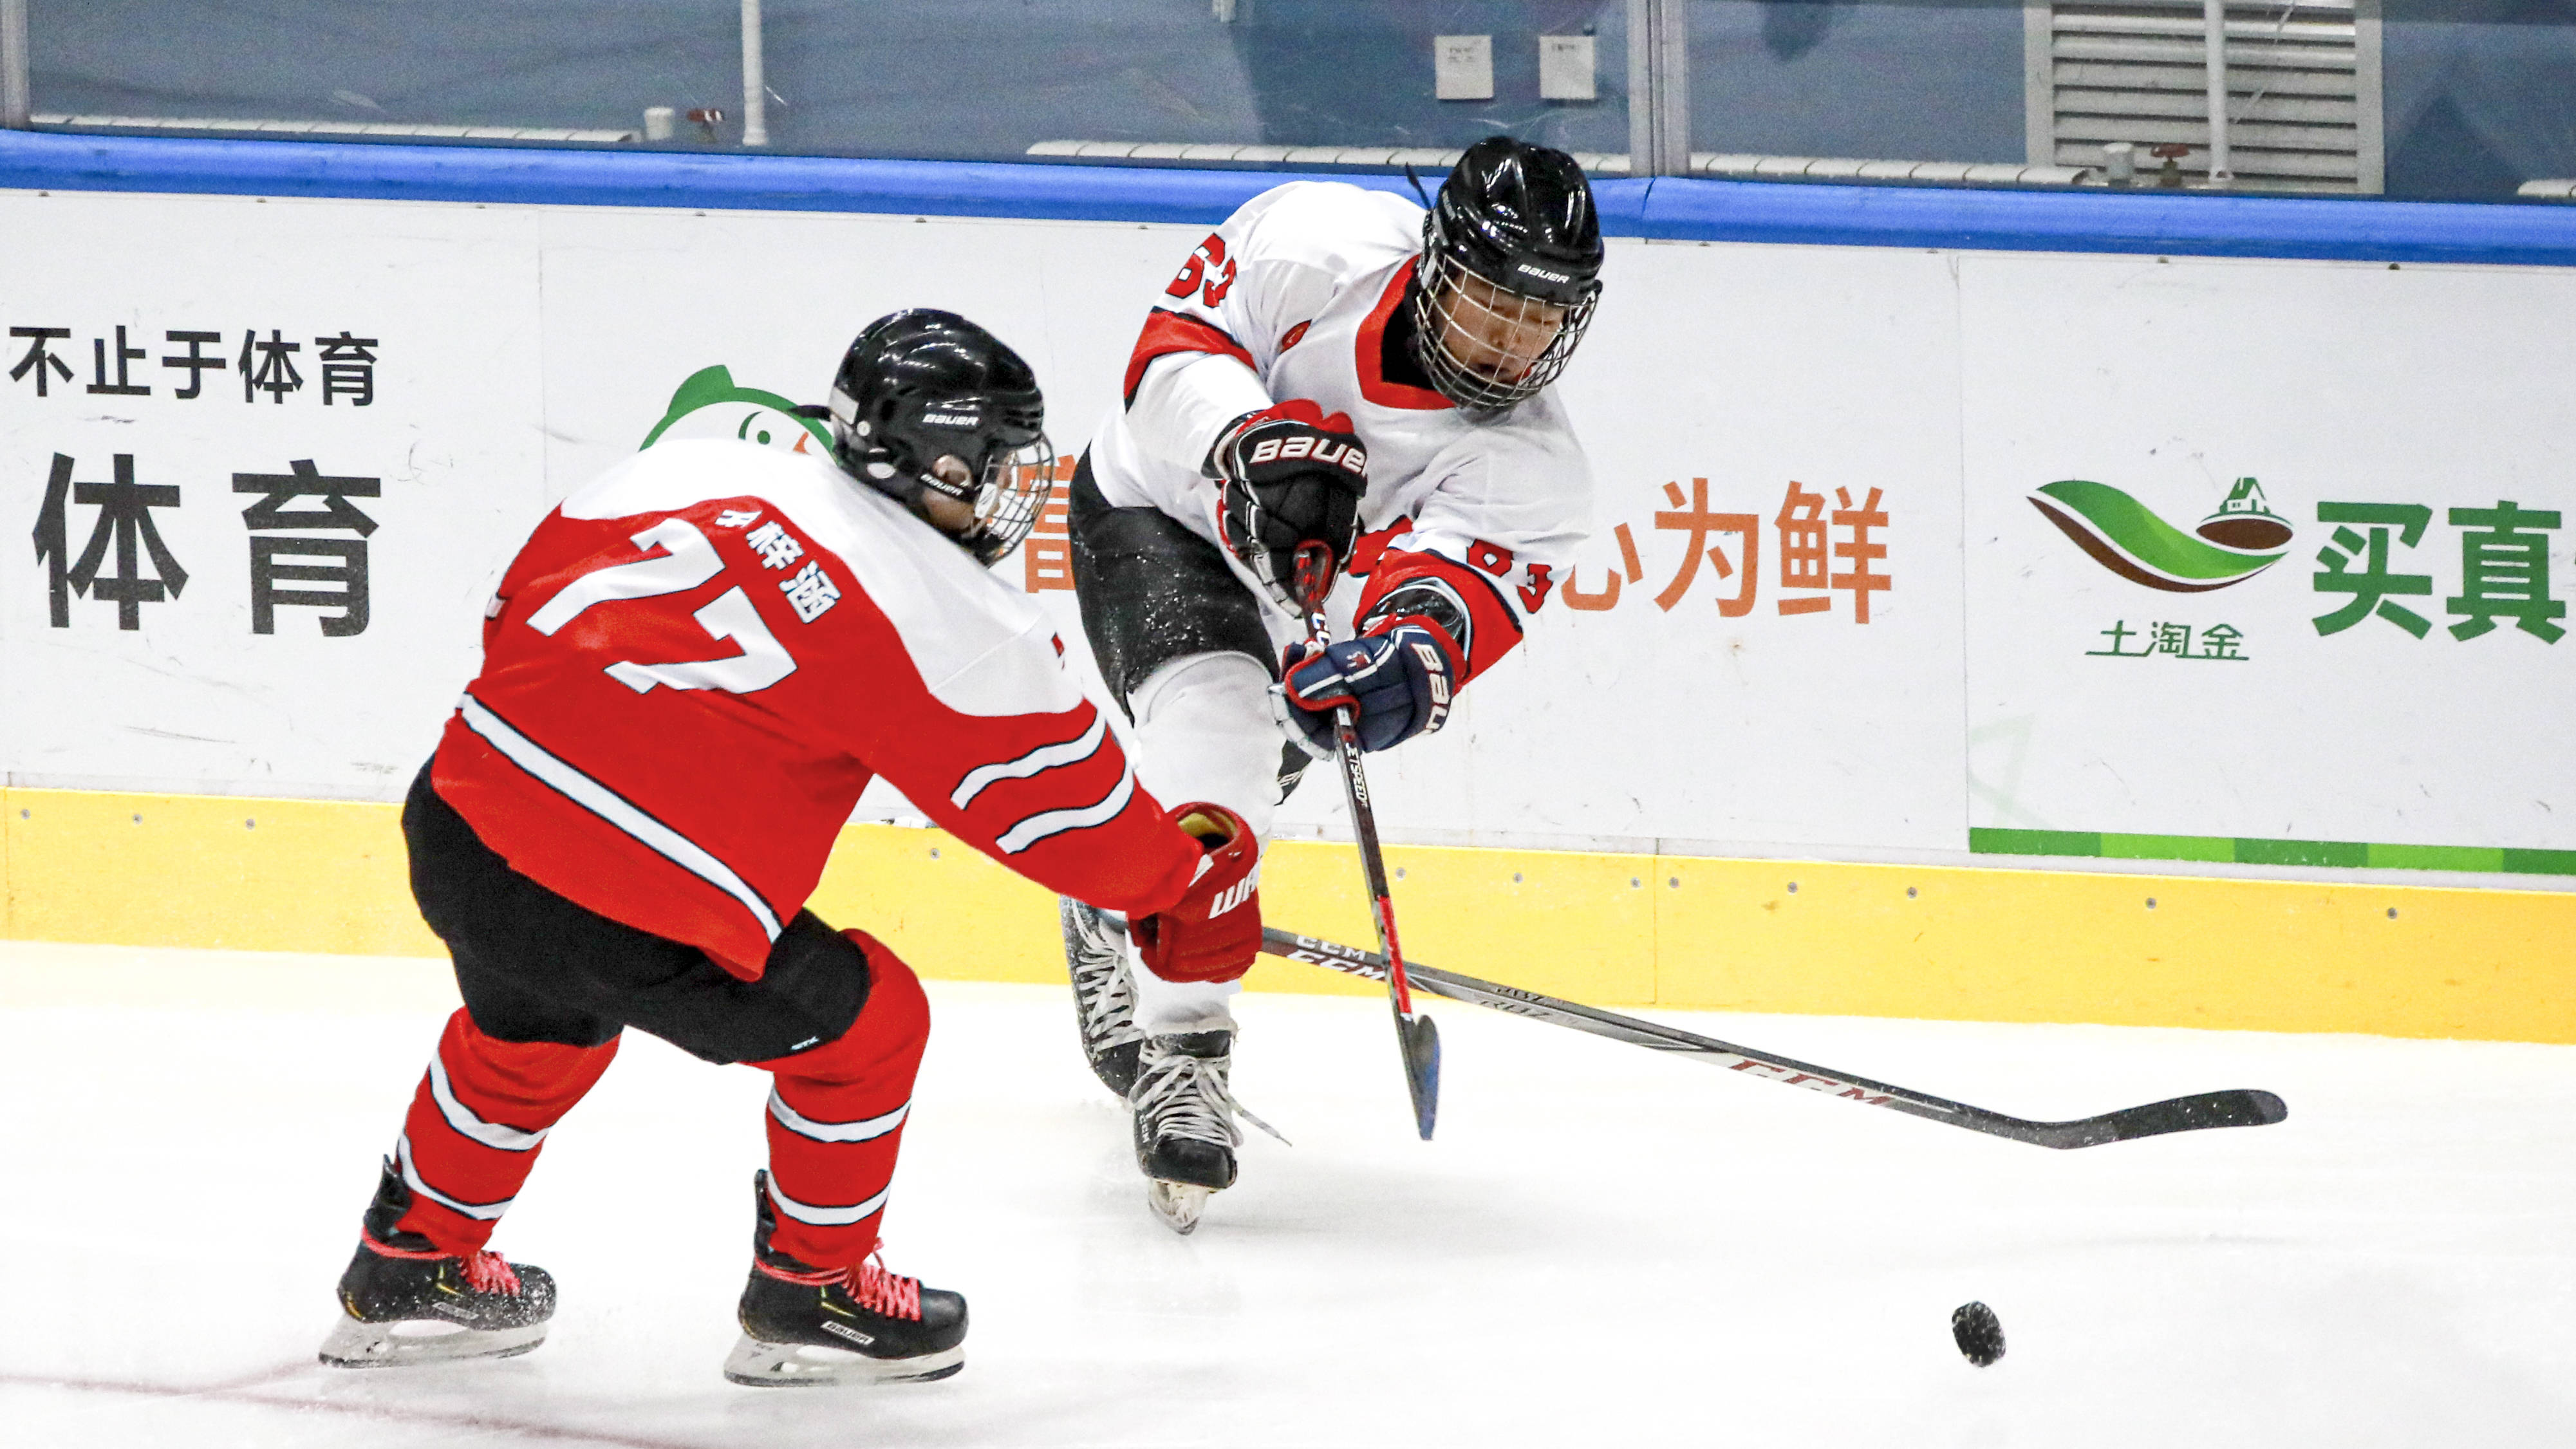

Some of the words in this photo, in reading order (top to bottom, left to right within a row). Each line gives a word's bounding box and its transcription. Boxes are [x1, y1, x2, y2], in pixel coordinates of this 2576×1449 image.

[1165, 232, 1237, 308] 63
[9, 324, 378, 407] 不止于体育
[1249, 436, 1367, 477] BAUE
[32, 451, 381, 637] 体育
[525, 518, 798, 695] 77
[2084, 620, 2250, 661] 土淘金
[1287, 949, 1386, 980] CCM
[1296, 935, 1366, 961] CCM
[1729, 1059, 1892, 1105] CCM
